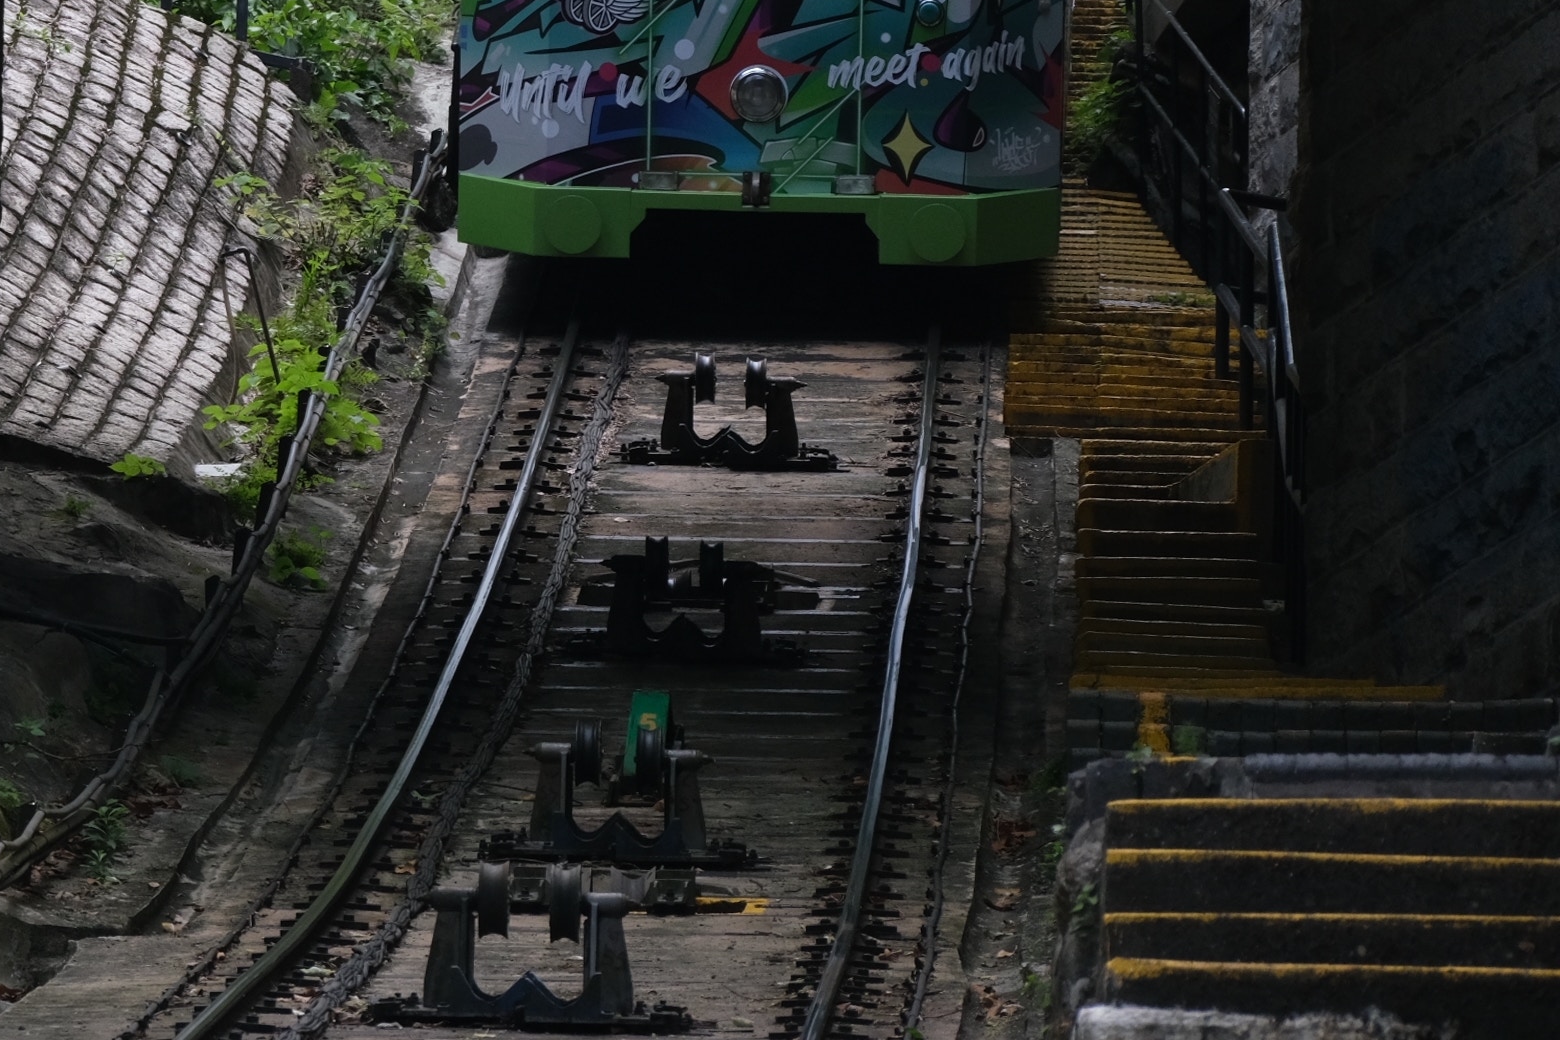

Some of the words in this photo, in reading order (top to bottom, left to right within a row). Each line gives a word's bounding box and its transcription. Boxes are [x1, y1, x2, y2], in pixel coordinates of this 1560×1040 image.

[616, 64, 687, 108] we
[827, 42, 931, 91] meet
[941, 30, 1025, 91] again
[639, 713, 657, 731] 5
